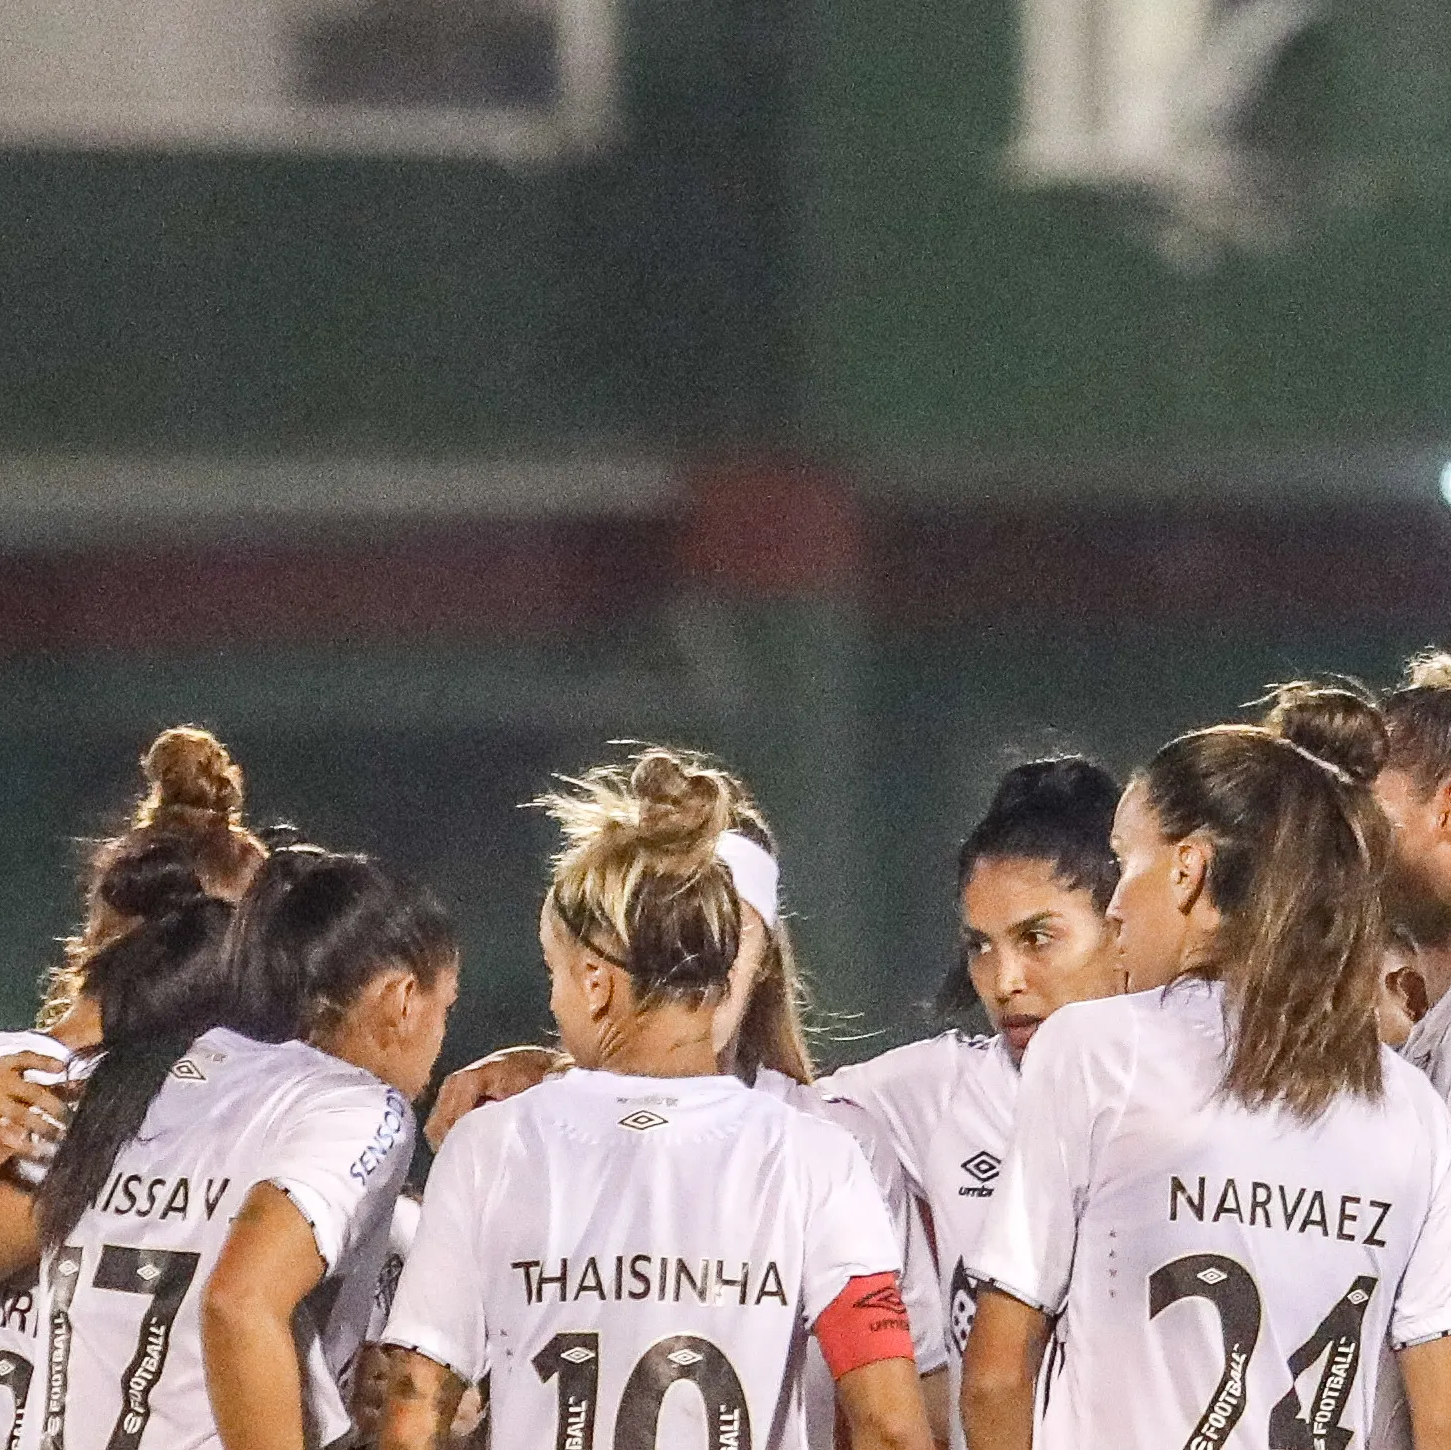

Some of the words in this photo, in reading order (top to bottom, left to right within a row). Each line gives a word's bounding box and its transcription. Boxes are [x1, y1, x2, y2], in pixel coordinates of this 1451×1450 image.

[90, 1172, 190, 1222] ISSA
[958, 1185, 995, 1198] umbr
[1169, 1175, 1393, 1248] NARVAEZ
[511, 1253, 789, 1307] THAISINHA
